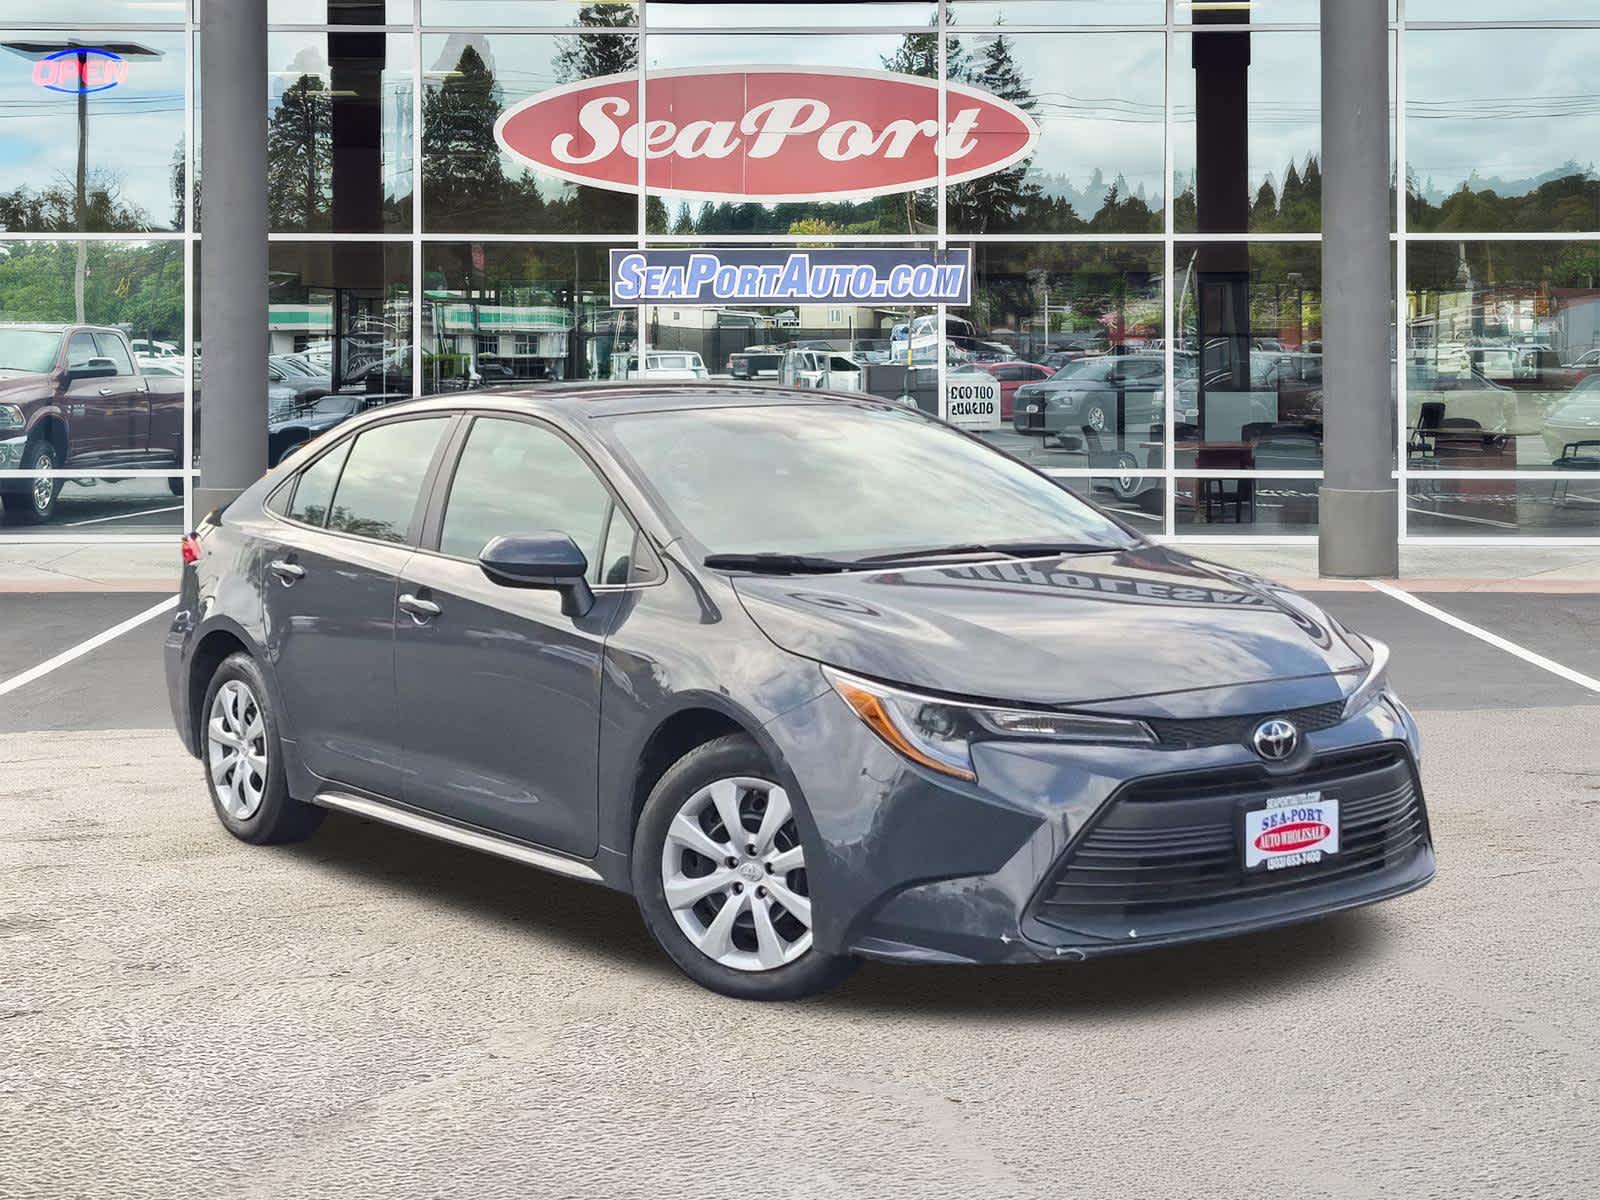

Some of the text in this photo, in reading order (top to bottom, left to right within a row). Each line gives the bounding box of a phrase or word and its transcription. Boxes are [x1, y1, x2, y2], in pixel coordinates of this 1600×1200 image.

[32, 59, 129, 86] OPEN
[550, 96, 982, 165] SeaPort
[1261, 808, 1323, 831] SEA-PORT
[1258, 825, 1326, 850] AUTO WHOLESALE
